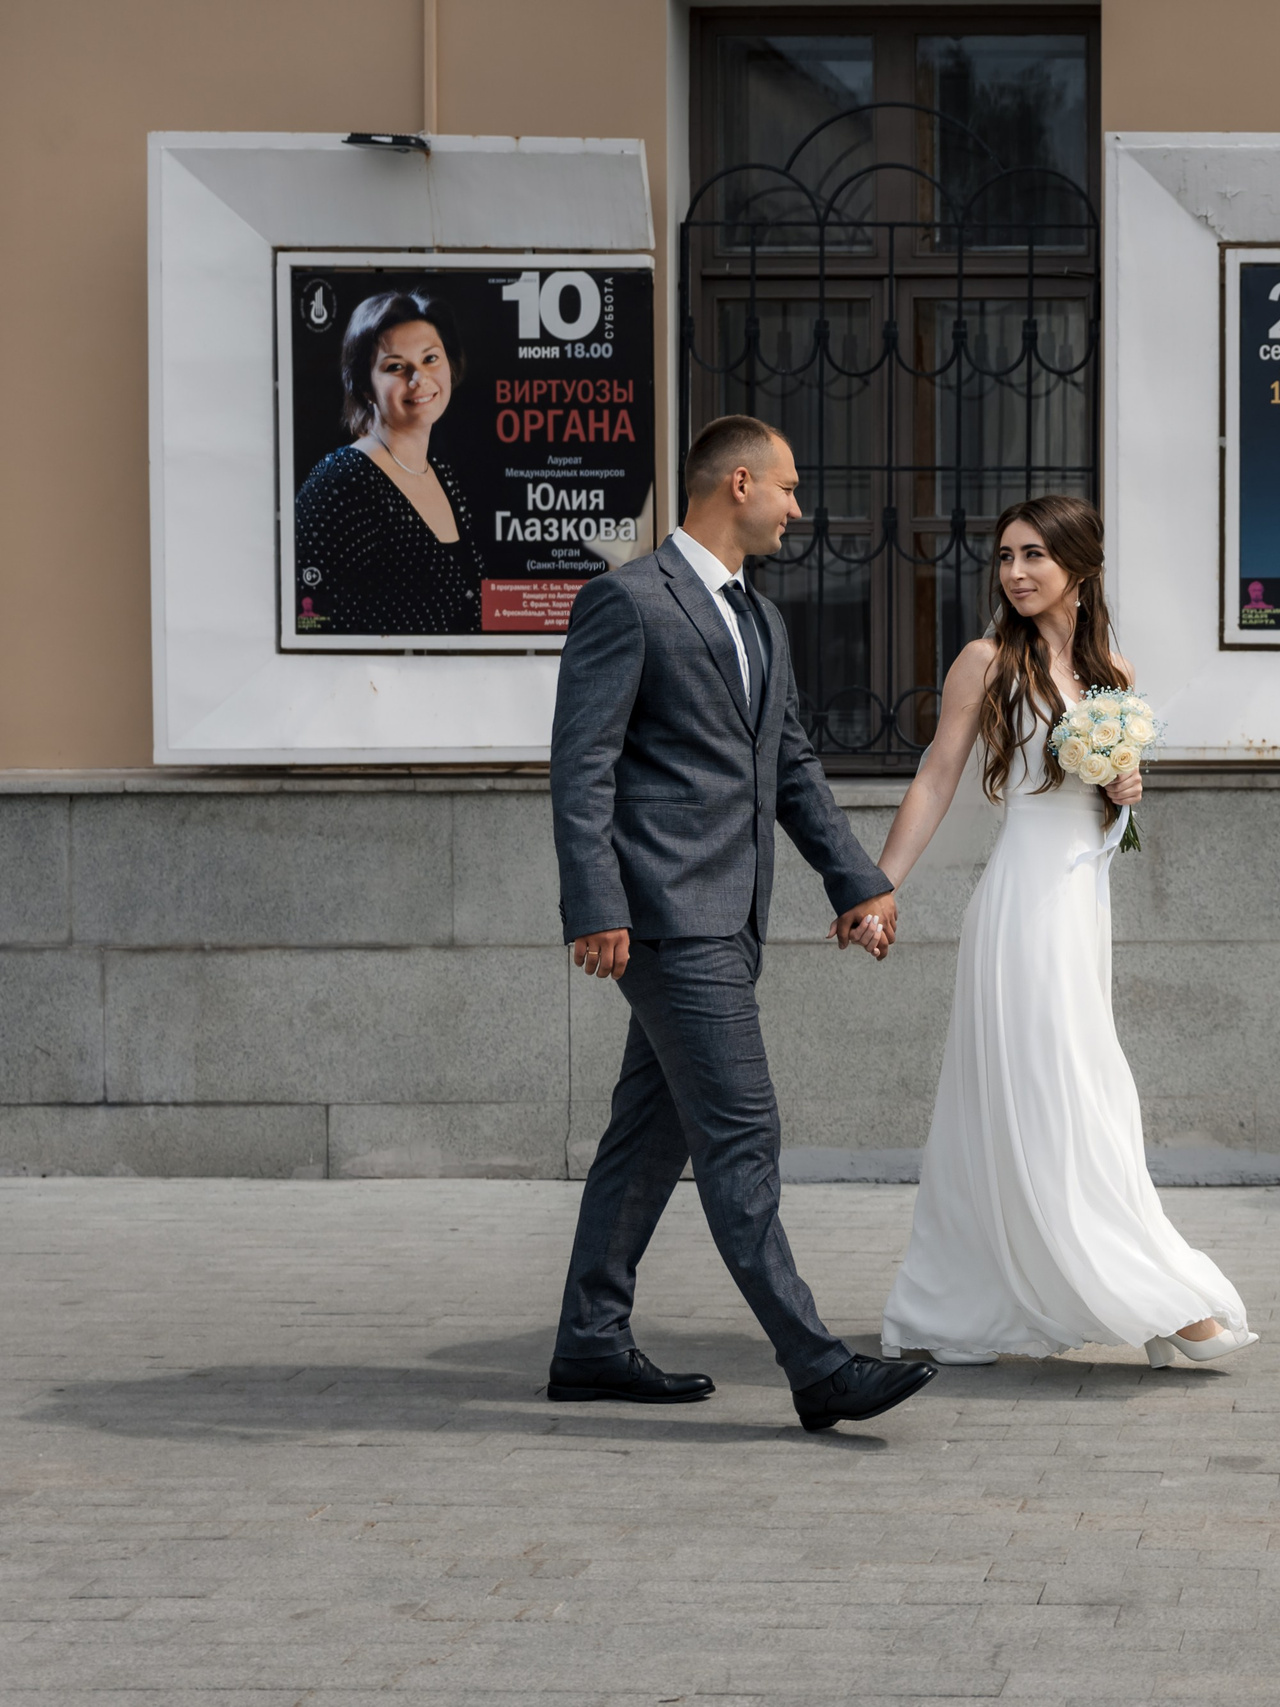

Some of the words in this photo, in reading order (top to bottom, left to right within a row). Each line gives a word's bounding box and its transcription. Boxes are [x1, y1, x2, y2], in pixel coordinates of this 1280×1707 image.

[502, 271, 601, 340] 10
[604, 277, 614, 339] СУББОТА
[564, 342, 613, 359] 18.00
[496, 379, 634, 403] ВИРТУОЗЫ
[496, 409, 636, 443] ОРГАНА
[547, 455, 583, 467] Лауреат
[505, 467, 577, 479] Международных
[579, 468, 626, 480] конкурсов
[527, 482, 605, 511] Юлия
[495, 511, 637, 542] Глазкова
[526, 559, 606, 571] (Санкт-Петербург)
[551, 548, 581, 558] орган
